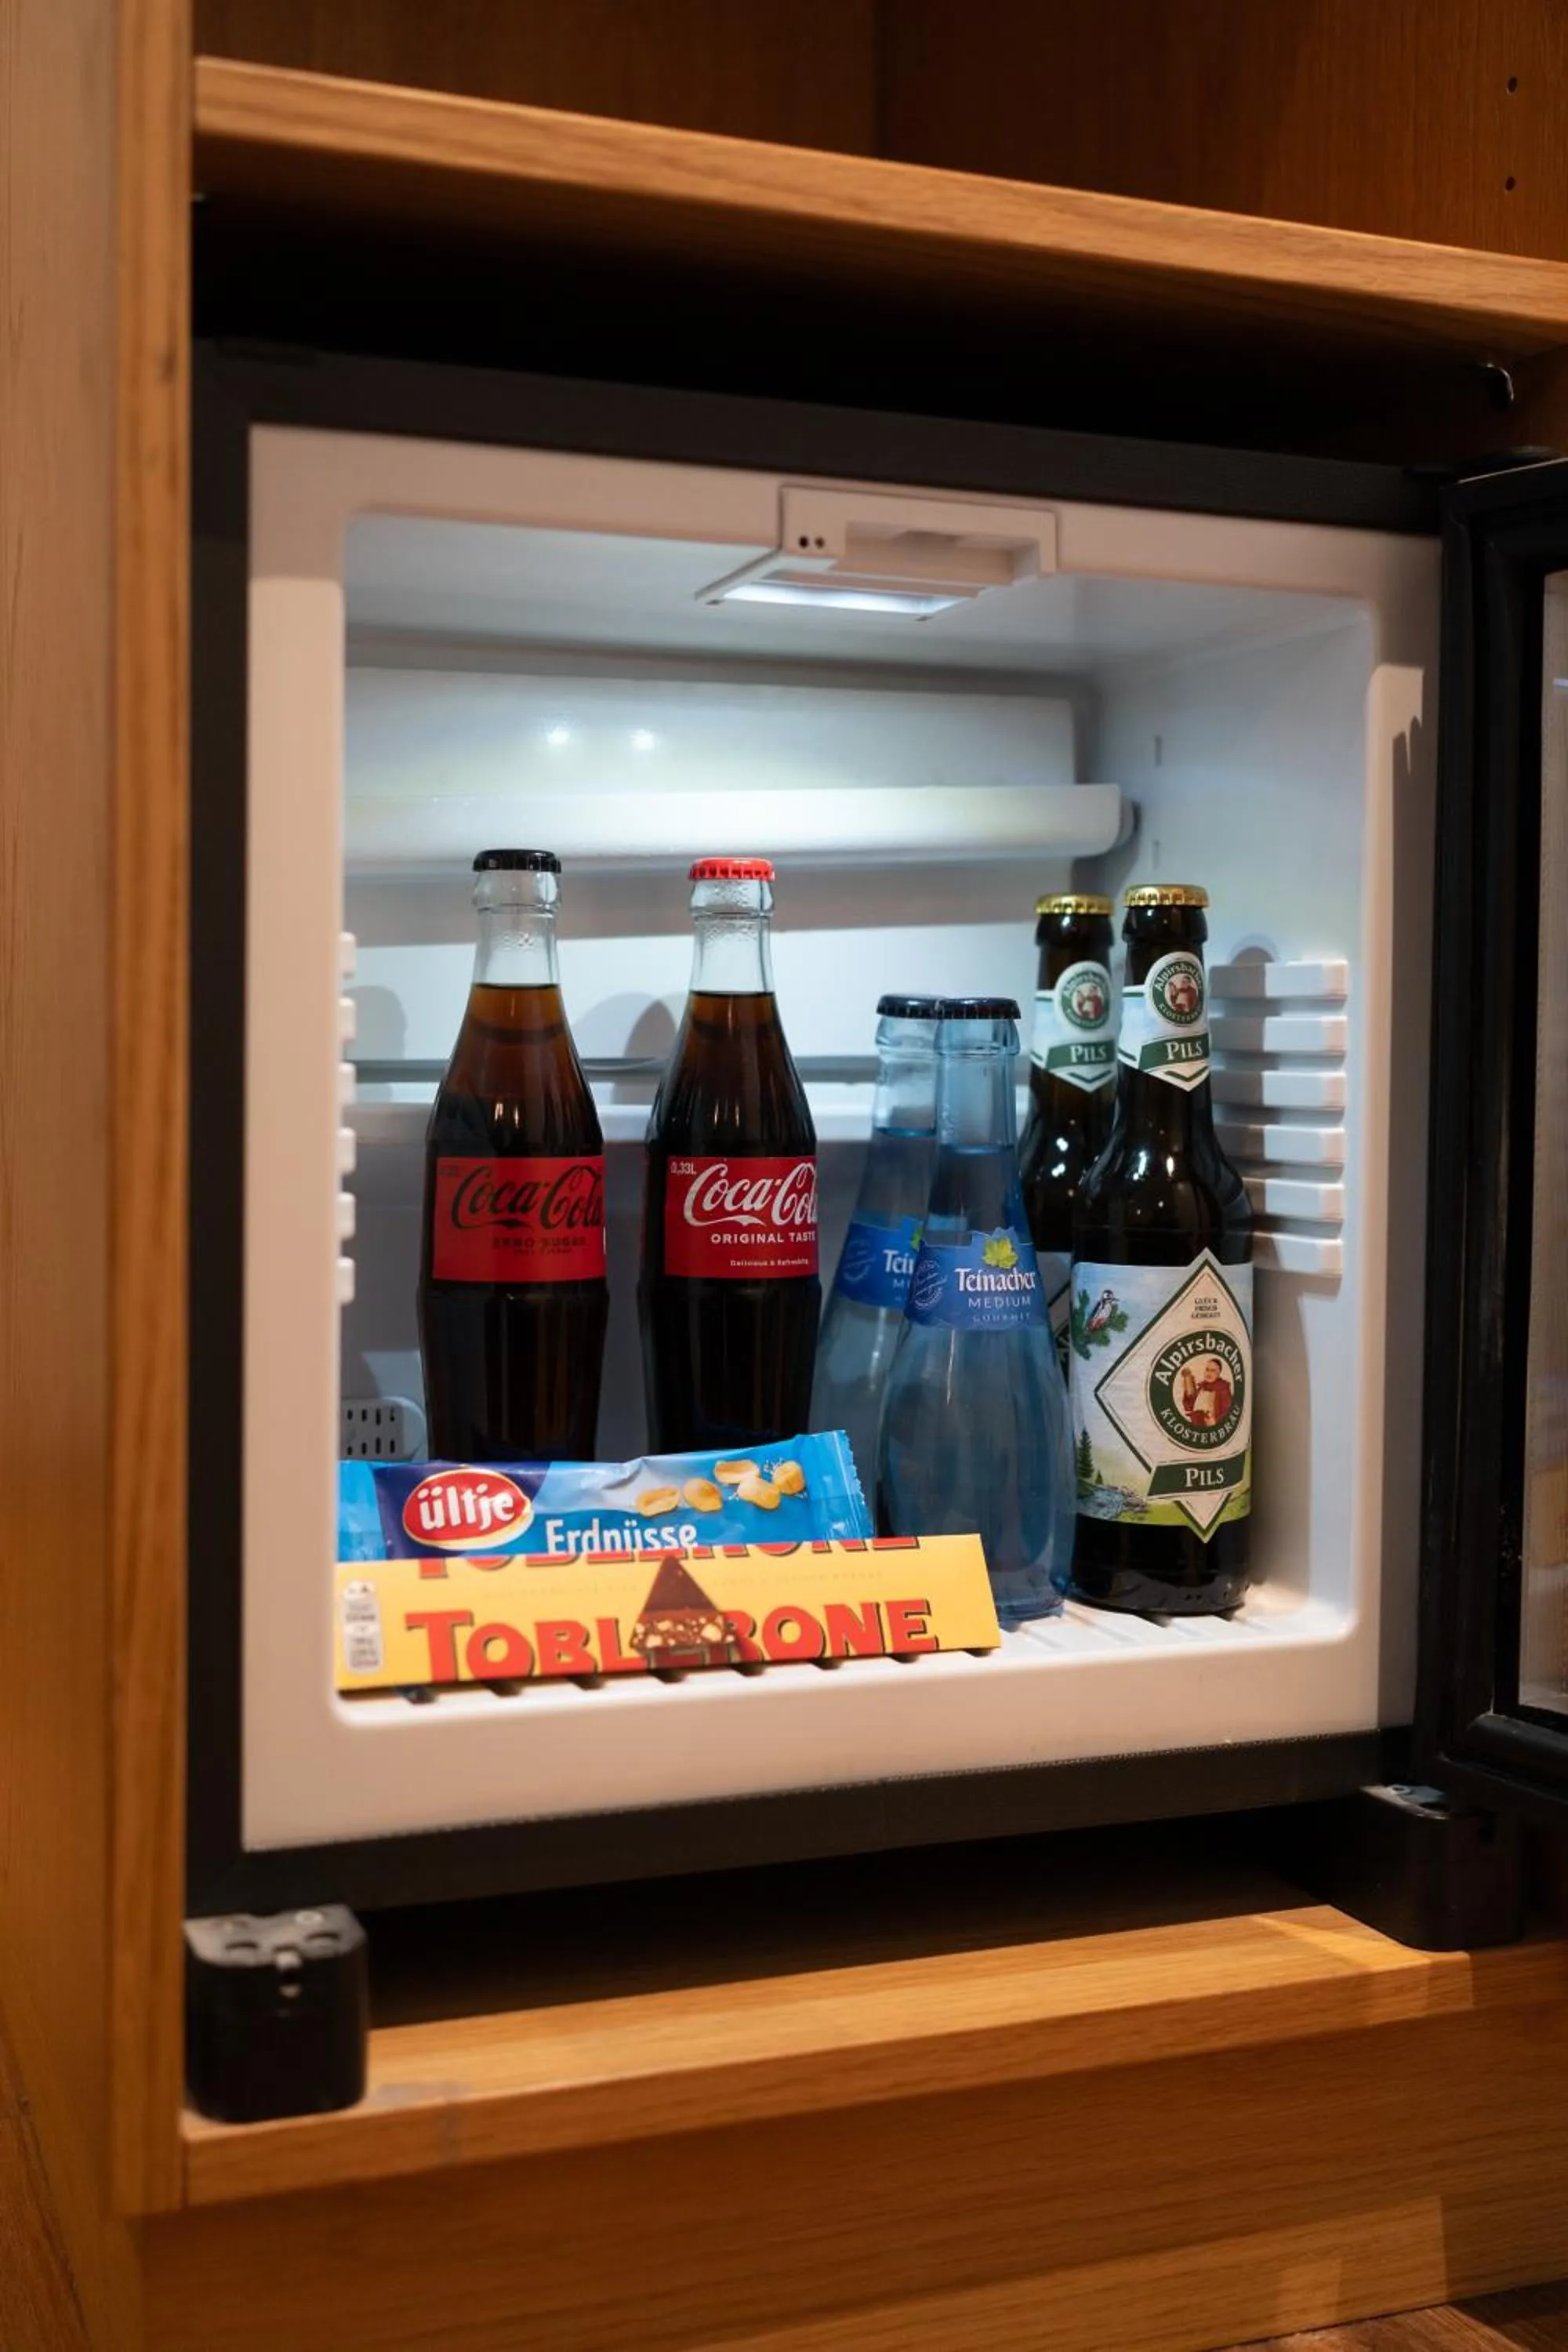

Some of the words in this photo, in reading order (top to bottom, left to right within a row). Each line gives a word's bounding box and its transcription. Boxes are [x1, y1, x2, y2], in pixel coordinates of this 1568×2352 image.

[1070, 1044, 1107, 1063] PILS
[1166, 1040, 1203, 1060] PILS
[711, 1233, 784, 1244] ORIGINAL
[953, 1267, 1036, 1292] Teinacher
[968, 1296, 1031, 1308] MEDIUM
[1155, 1333, 1243, 1386] Alpirsbacher
[1185, 1467, 1225, 1486] PILS
[417, 1483, 516, 1530] ültje
[546, 1518, 698, 1554] Erdnüsse
[405, 1598, 940, 1682] TOBLRONE
